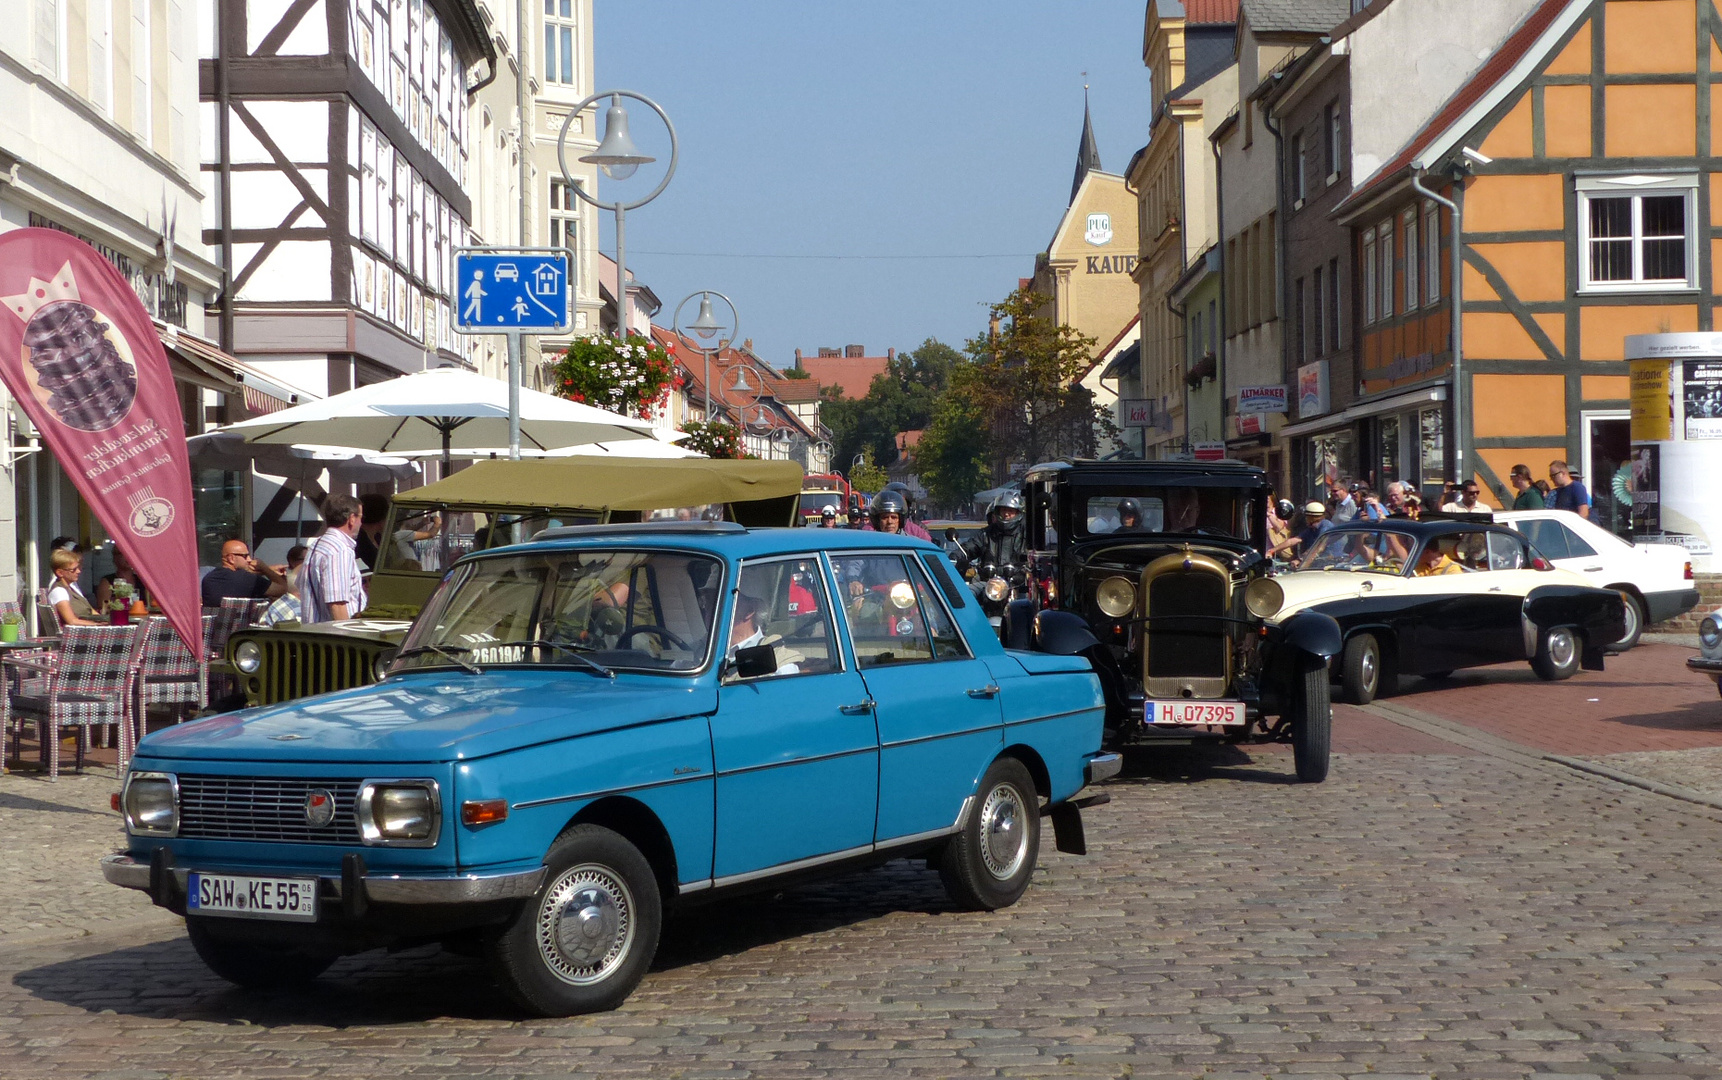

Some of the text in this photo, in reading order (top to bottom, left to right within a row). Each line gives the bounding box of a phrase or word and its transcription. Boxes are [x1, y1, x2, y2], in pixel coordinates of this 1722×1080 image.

[1089, 219, 1108, 230] PUG
[1240, 386, 1285, 400] ALTMÄRKER
[1162, 705, 1173, 721] H
[1184, 706, 1235, 722] 07395
[201, 877, 235, 907] SAW
[249, 880, 273, 910] KE
[276, 882, 300, 911] 55
[302, 903, 312, 912] 09
